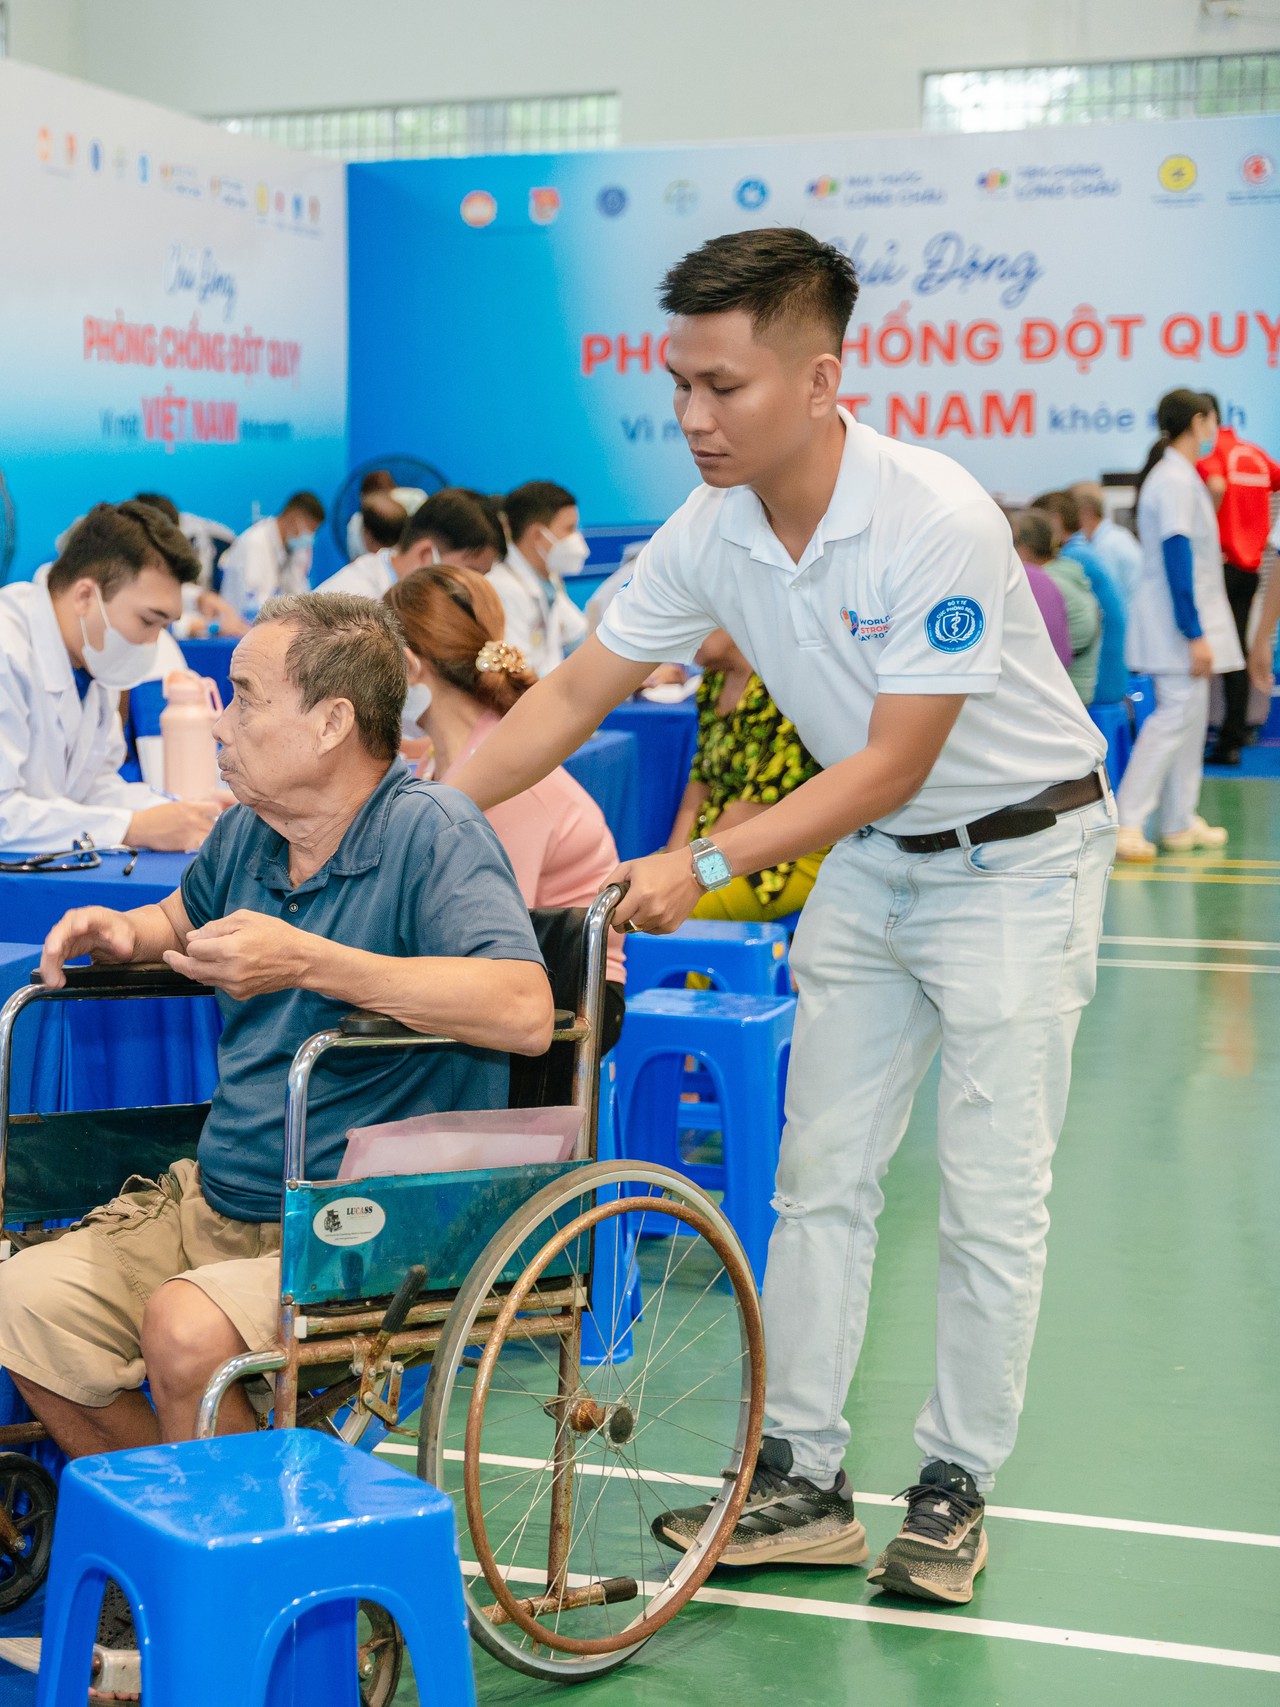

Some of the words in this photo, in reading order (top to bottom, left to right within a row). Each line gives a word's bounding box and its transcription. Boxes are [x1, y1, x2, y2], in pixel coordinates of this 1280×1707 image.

[912, 230, 1044, 310] Động
[841, 300, 1002, 368] HỐNG
[1016, 303, 1146, 374] ĐỘT
[886, 389, 1037, 440] NAM
[346, 1205, 373, 1216] LUCASS
